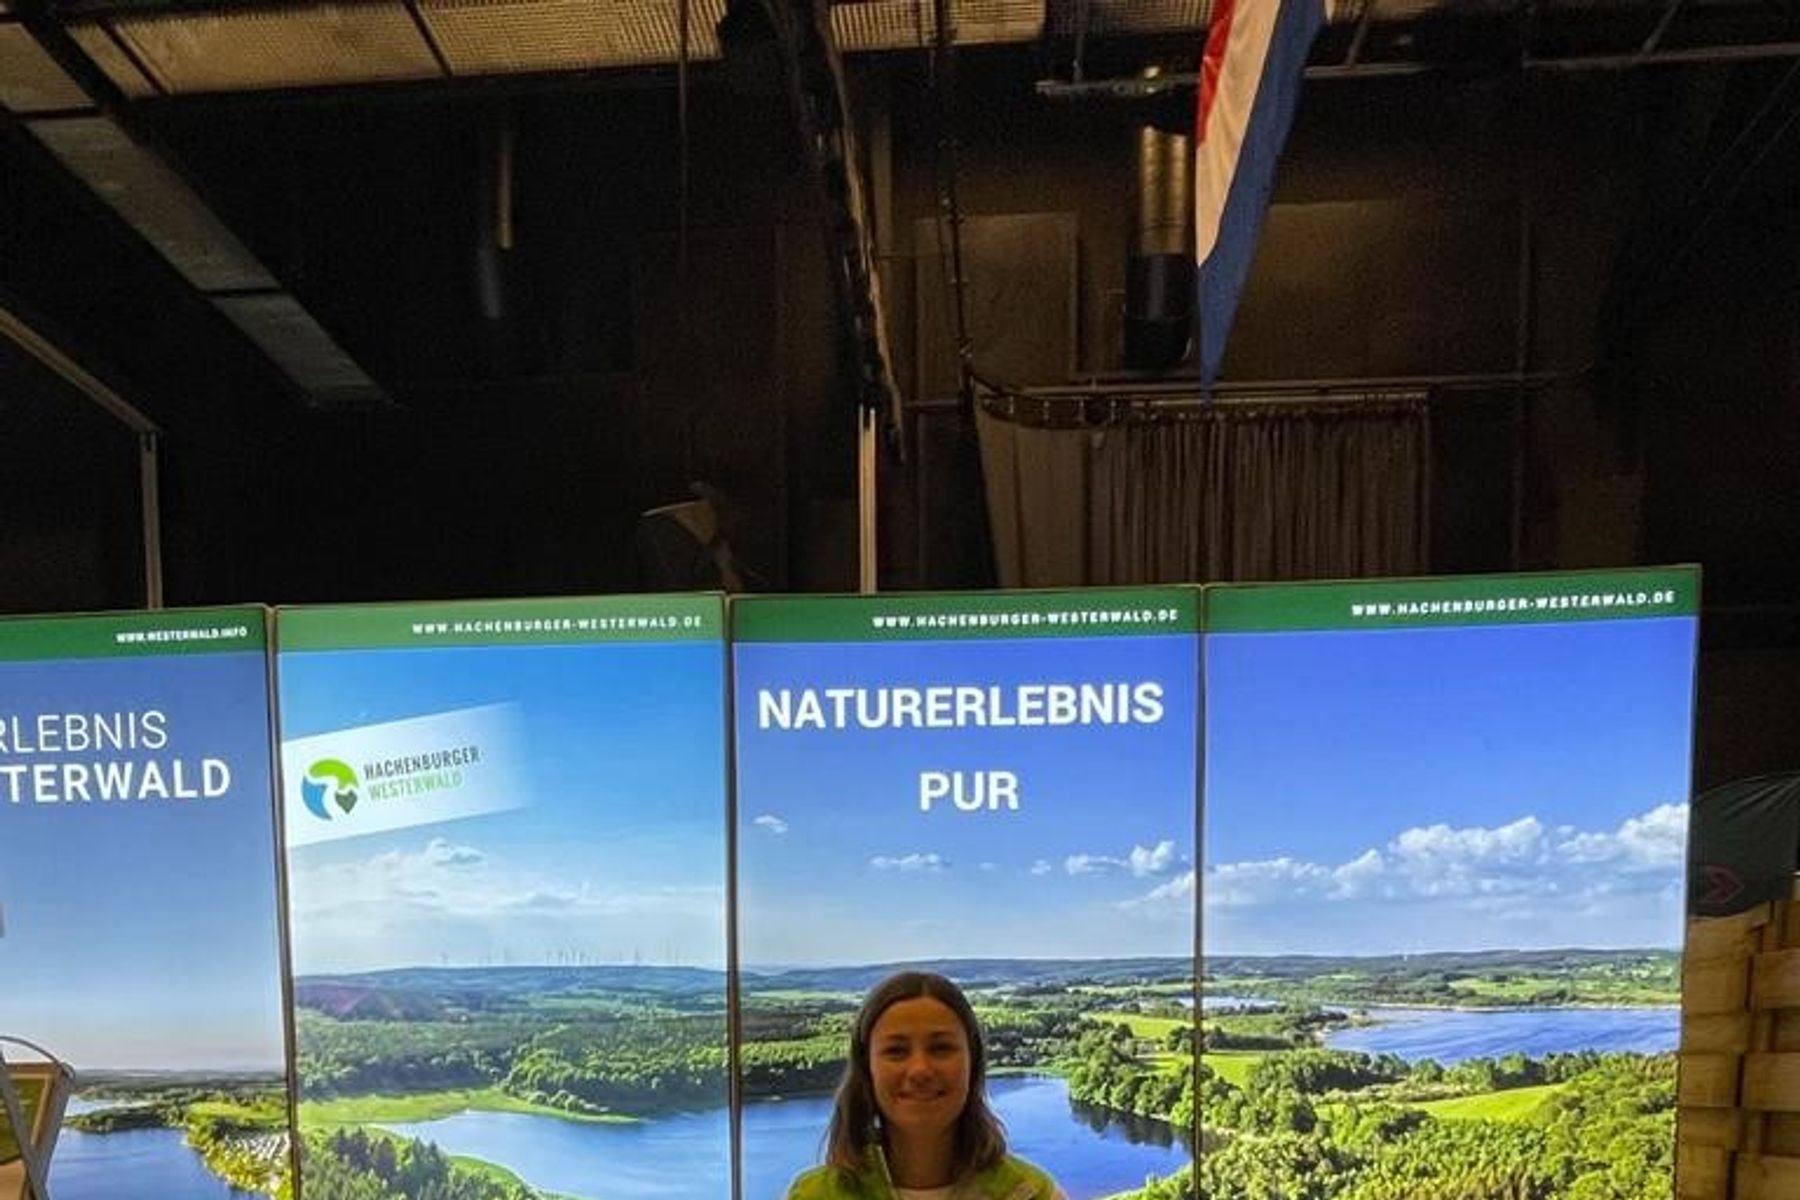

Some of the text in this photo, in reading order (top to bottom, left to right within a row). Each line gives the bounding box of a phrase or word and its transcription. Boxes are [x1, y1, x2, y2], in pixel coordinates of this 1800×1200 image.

[872, 608, 1178, 629] WWW.HACHENBURGER-WESTERWALD.DE
[1351, 590, 1676, 616] WWW.HACHENBURGER-WESTERWALD.DE
[116, 626, 247, 643] WWW.WESTERWALD.INFO
[758, 682, 1165, 730] NATURERLEBNIS
[364, 745, 481, 781] HACHENBURGER
[368, 771, 463, 802] WESTERWALD
[919, 771, 1019, 811] PUR
